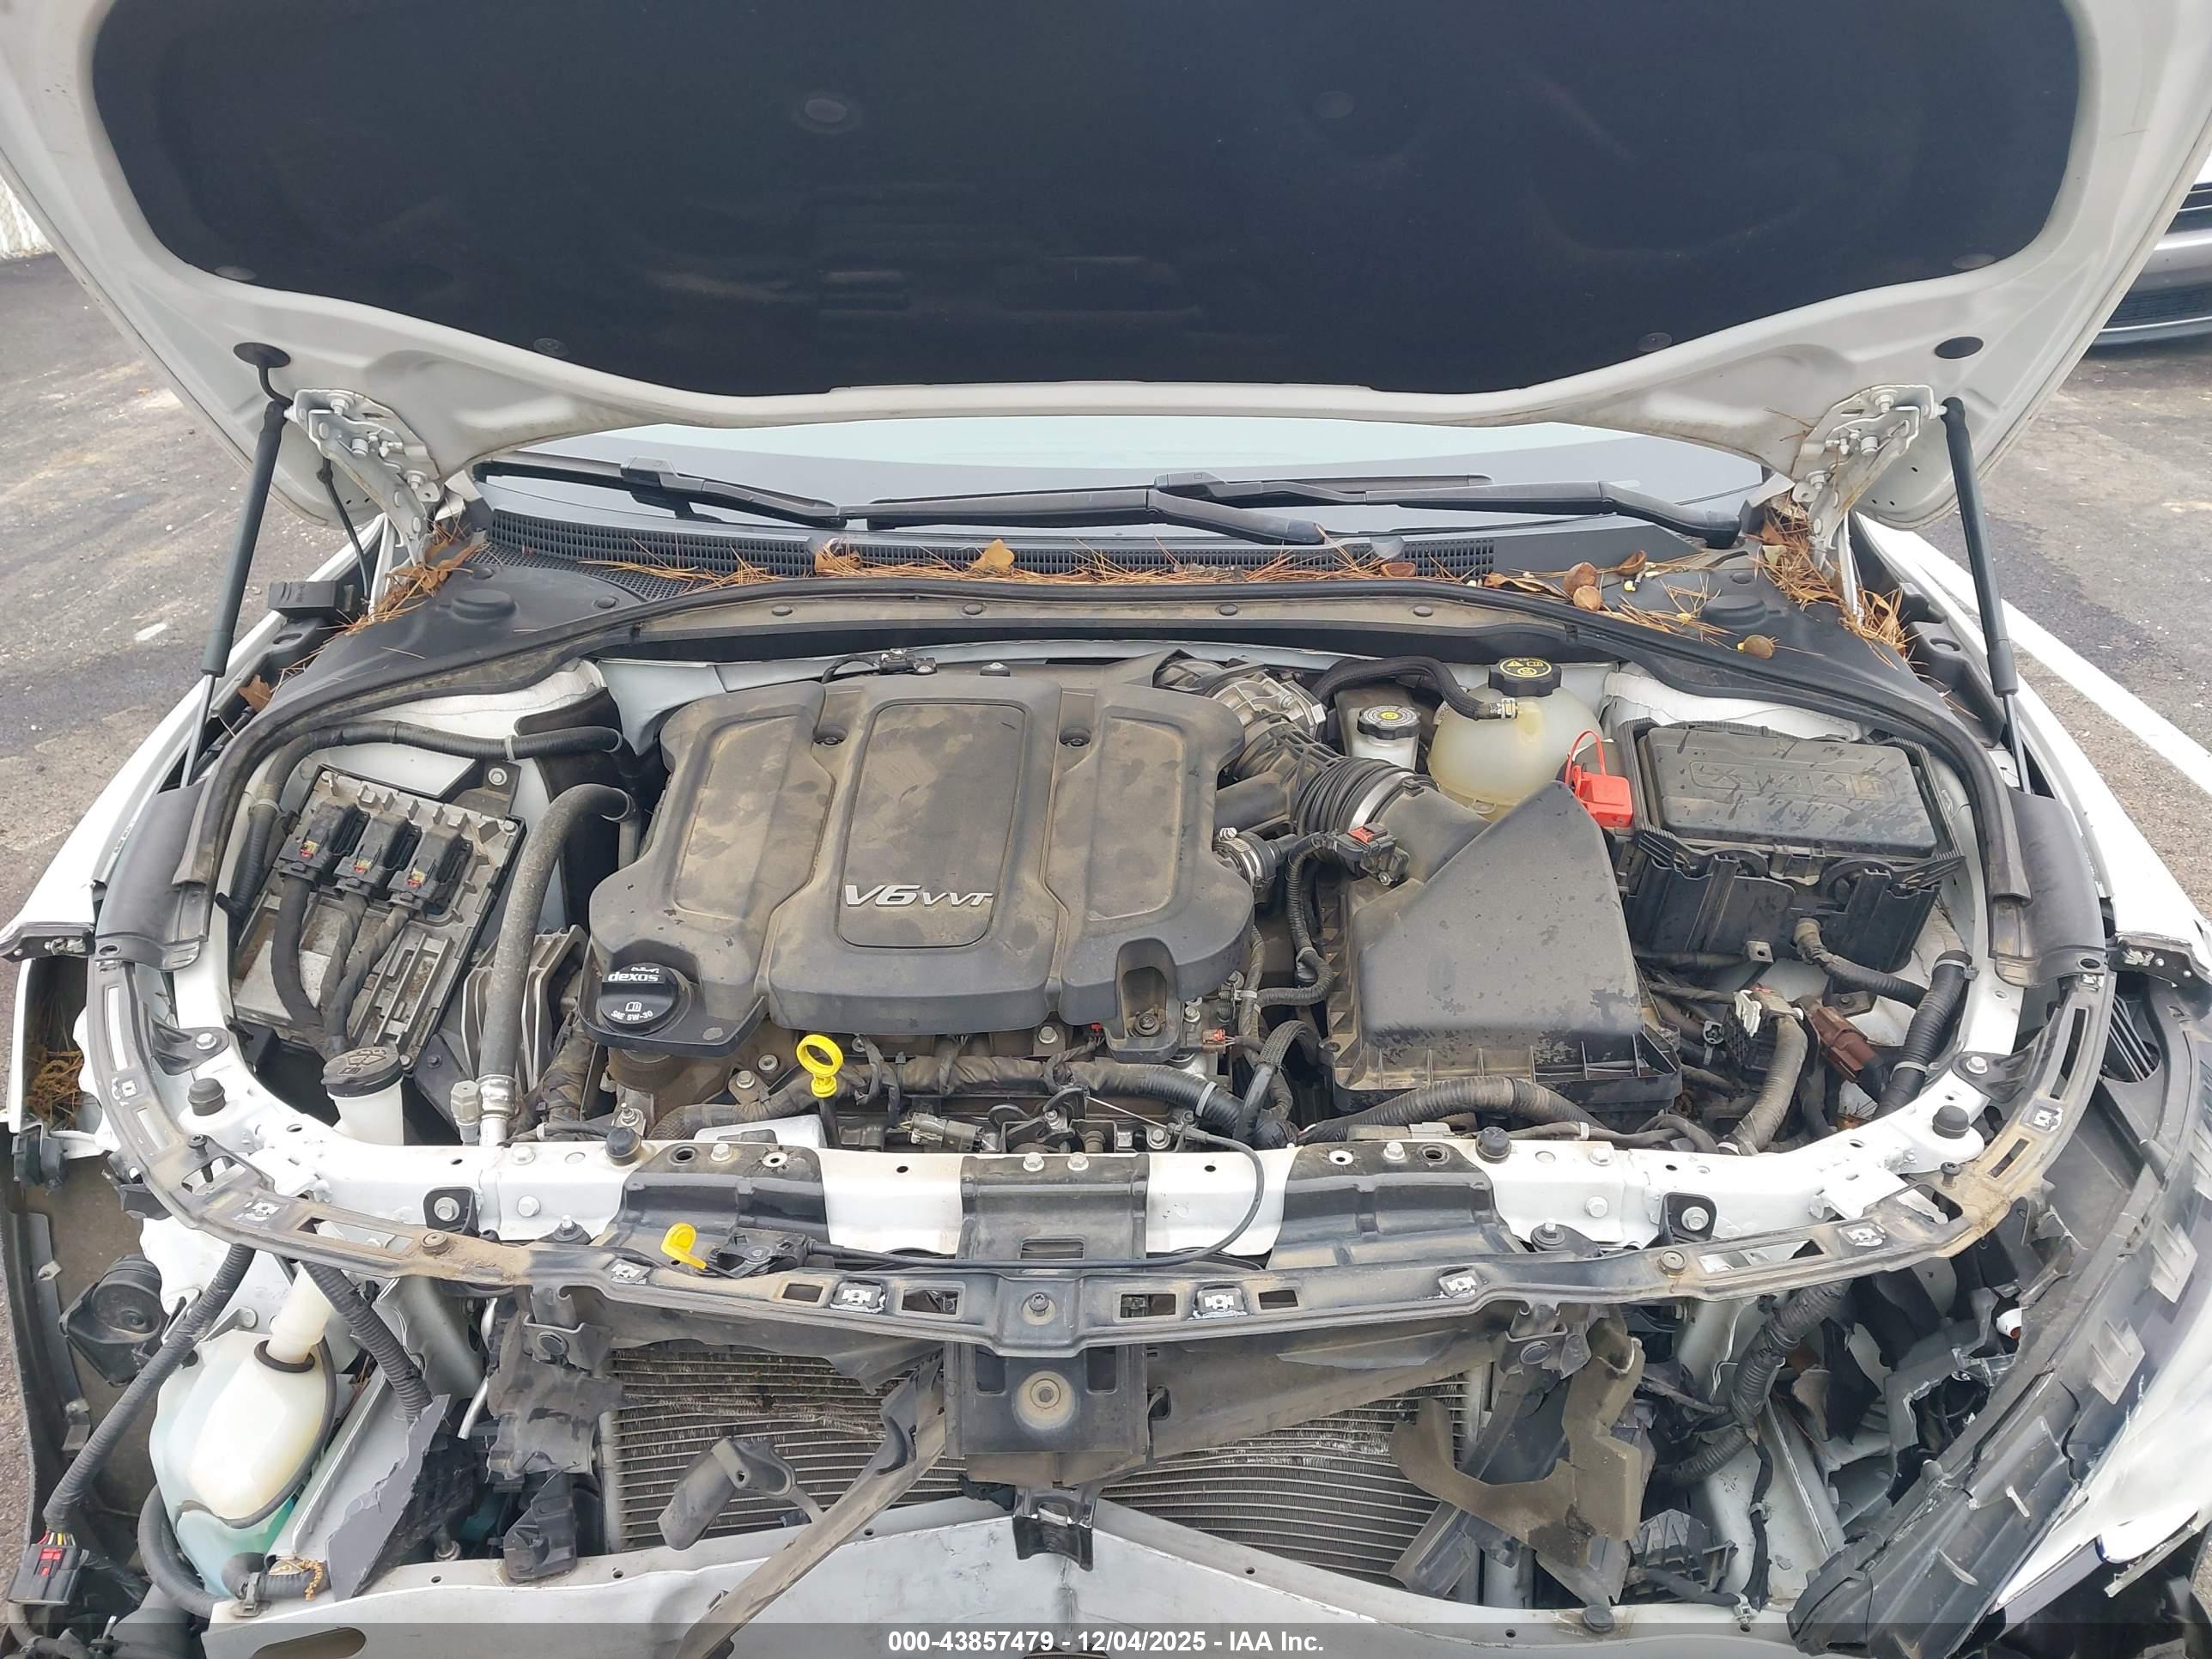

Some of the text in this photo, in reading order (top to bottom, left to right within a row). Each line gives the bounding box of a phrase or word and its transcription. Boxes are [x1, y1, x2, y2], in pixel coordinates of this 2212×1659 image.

[844, 884, 994, 907] V6 VVT
[608, 971, 660, 981] dexos
[611, 1010, 653, 1021] SAE 5W-30
